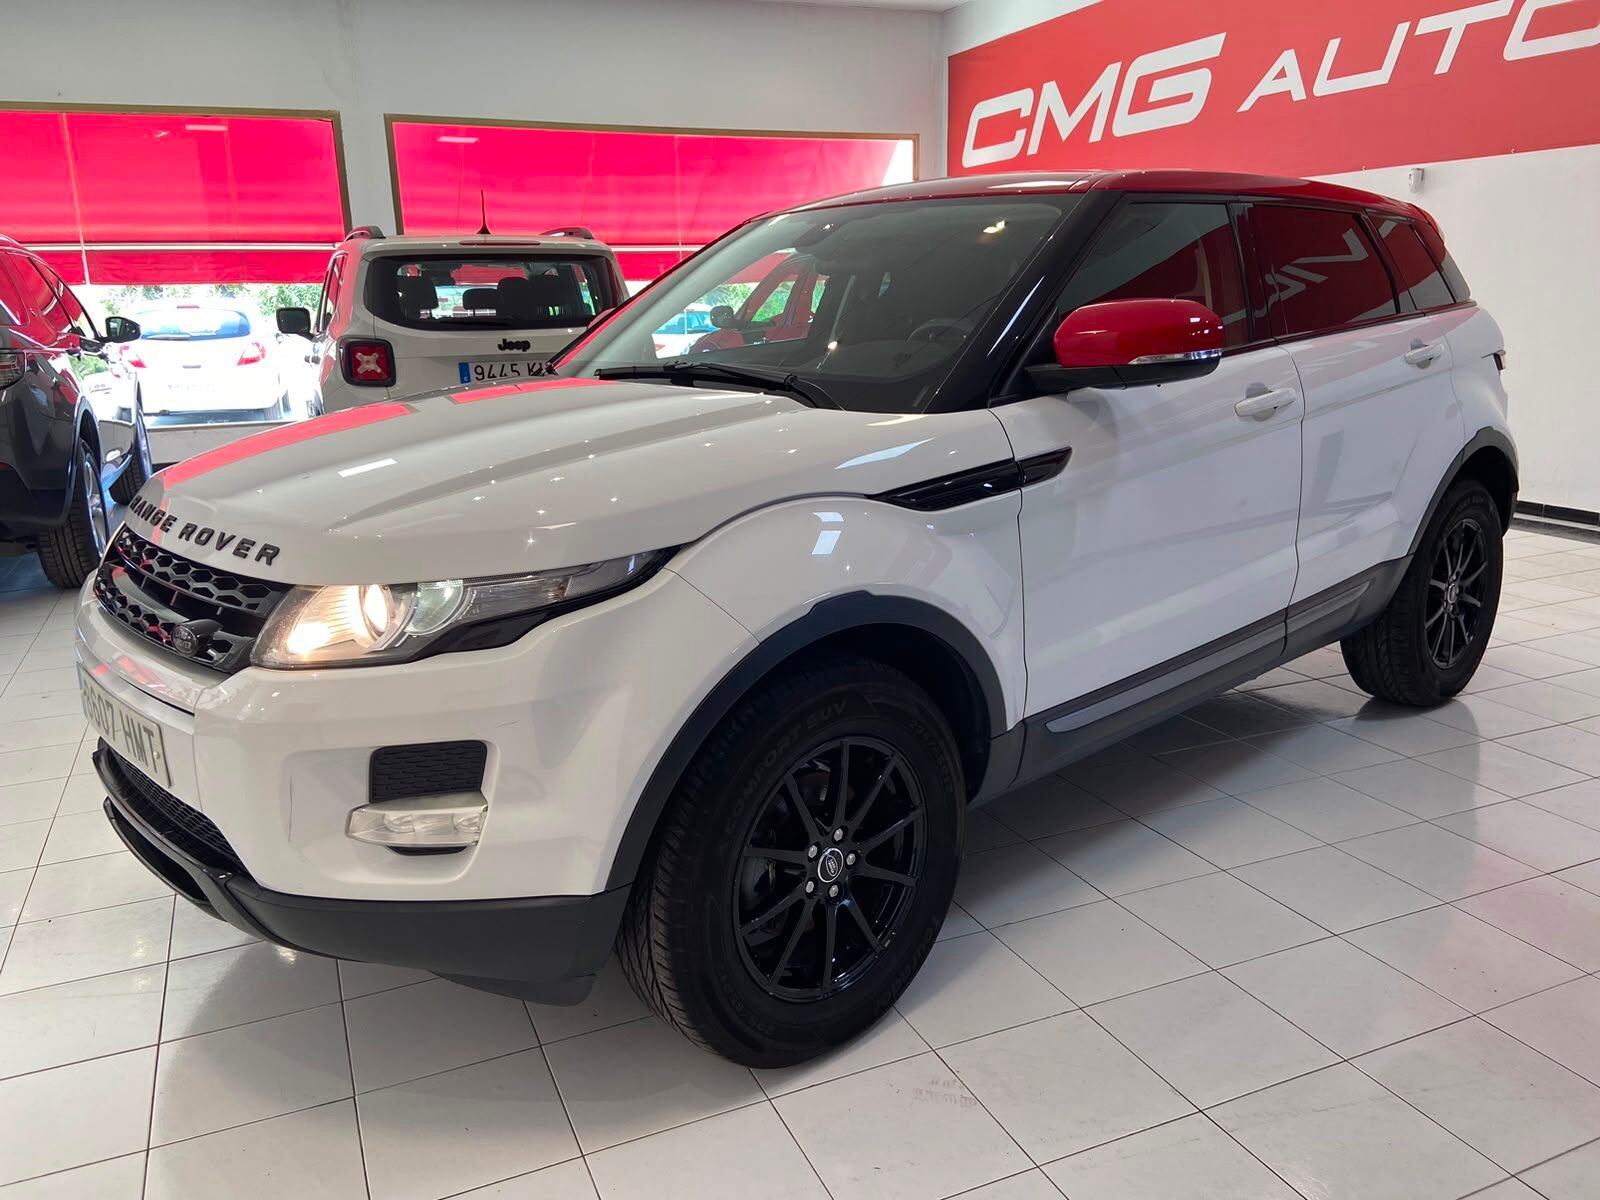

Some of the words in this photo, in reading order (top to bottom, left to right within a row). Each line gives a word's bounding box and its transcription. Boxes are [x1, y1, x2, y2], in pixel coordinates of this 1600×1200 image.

[961, 31, 1227, 169] CMG
[1236, 0, 1600, 113] AUTO
[473, 363, 521, 381] 9445
[497, 338, 531, 352] Jeep
[129, 494, 178, 533] RANGE
[177, 522, 281, 567] ROVER
[118, 709, 158, 774] HMT
